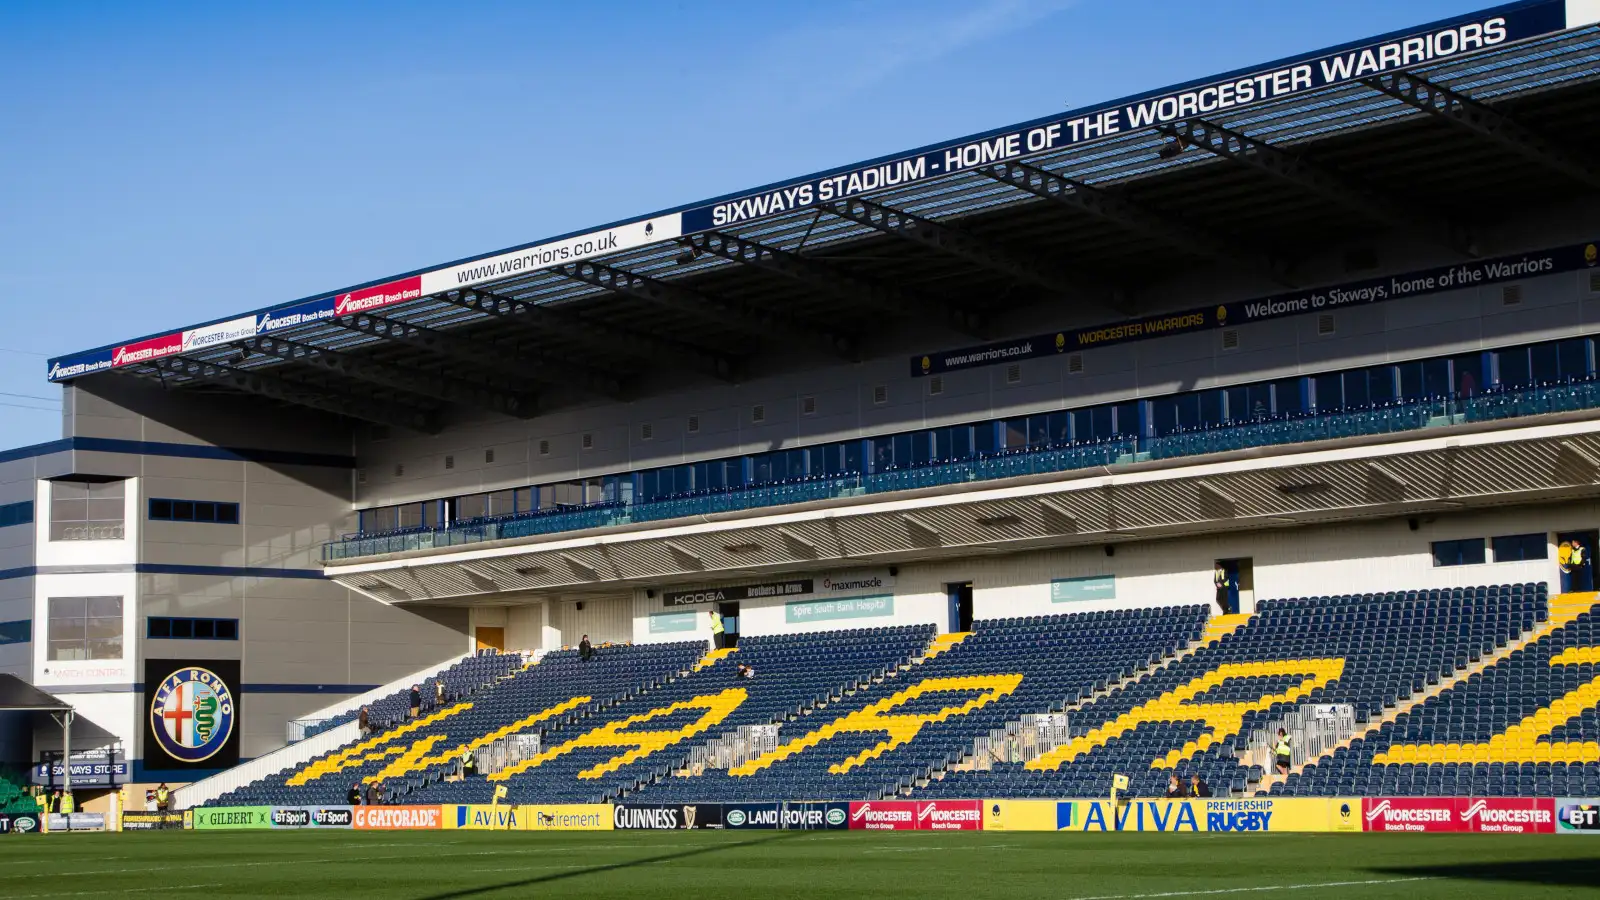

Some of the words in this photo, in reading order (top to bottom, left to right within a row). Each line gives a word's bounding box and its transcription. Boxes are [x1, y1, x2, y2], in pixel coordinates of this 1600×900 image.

[712, 184, 813, 226] SIXWAYS
[819, 157, 925, 200] STADIUM
[945, 133, 1020, 172] HOME
[1027, 124, 1061, 152] OF
[1067, 107, 1120, 142] THE
[1126, 64, 1312, 129] WORCESTER
[1320, 17, 1507, 84] WARRIORS
[457, 232, 618, 283] www.warriors.co.uk
[1245, 297, 1309, 319] Welcome
[1310, 293, 1326, 307] to
[1329, 286, 1389, 306] Sixways,
[1391, 276, 1435, 295] home
[1438, 268, 1456, 288] of
[1457, 265, 1482, 283] the
[1485, 257, 1553, 279] Warriors
[346, 294, 384, 312] WORCESTER
[385, 292, 402, 303] Bosch
[403, 288, 420, 300] Group
[266, 314, 301, 330] WORCESTER
[302, 312, 318, 322] Bosch
[319, 308, 335, 318] Group
[192, 332, 225, 346] WORCESTER
[226, 330, 240, 339] Bosch
[241, 327, 255, 336] Group
[1078, 324, 1142, 345] WORCESTER
[1145, 313, 1204, 333] WARRIORS
[122, 348, 153, 363] WORCESTER
[167, 345, 182, 354] Group
[945, 342, 1032, 367] www.warriors.co.uk
[56, 364, 86, 378] WORCESTER
[99, 361, 112, 369] Group
[832, 577, 881, 590] maximuscle
[674, 591, 725, 605] KOOGA
[748, 585, 776, 597] Brothers
[793, 606, 812, 618] Spire
[814, 604, 835, 613] South
[837, 603, 853, 612] Bank
[857, 600, 885, 612] Hospital
[154, 676, 182, 717] ALFA
[190, 670, 231, 715] ROMEO
[94, 765, 124, 773] STORE
[1207, 801, 1273, 811] PREMIERSHIP
[210, 811, 253, 825] GILBERT
[276, 813, 286, 822] BT
[286, 812, 306, 824] Sport
[317, 813, 328, 822] BT
[328, 811, 348, 824] Sport
[614, 804, 677, 828] GUINNESS
[748, 810, 777, 825] LAND
[865, 810, 912, 822] WORCESTER
[931, 810, 980, 822] WORCESTER
[1083, 802, 1199, 832] AVIVA
[1207, 811, 1273, 832] RUGBY
[1384, 809, 1451, 821] WORCESTER
[1479, 809, 1551, 823] WORCESTER
[1570, 810, 1597, 825] BT
[1385, 823, 1404, 831] Bosch
[1405, 823, 1425, 832] Group
[1481, 824, 1501, 832] Bosch
[1502, 824, 1523, 833] Group
